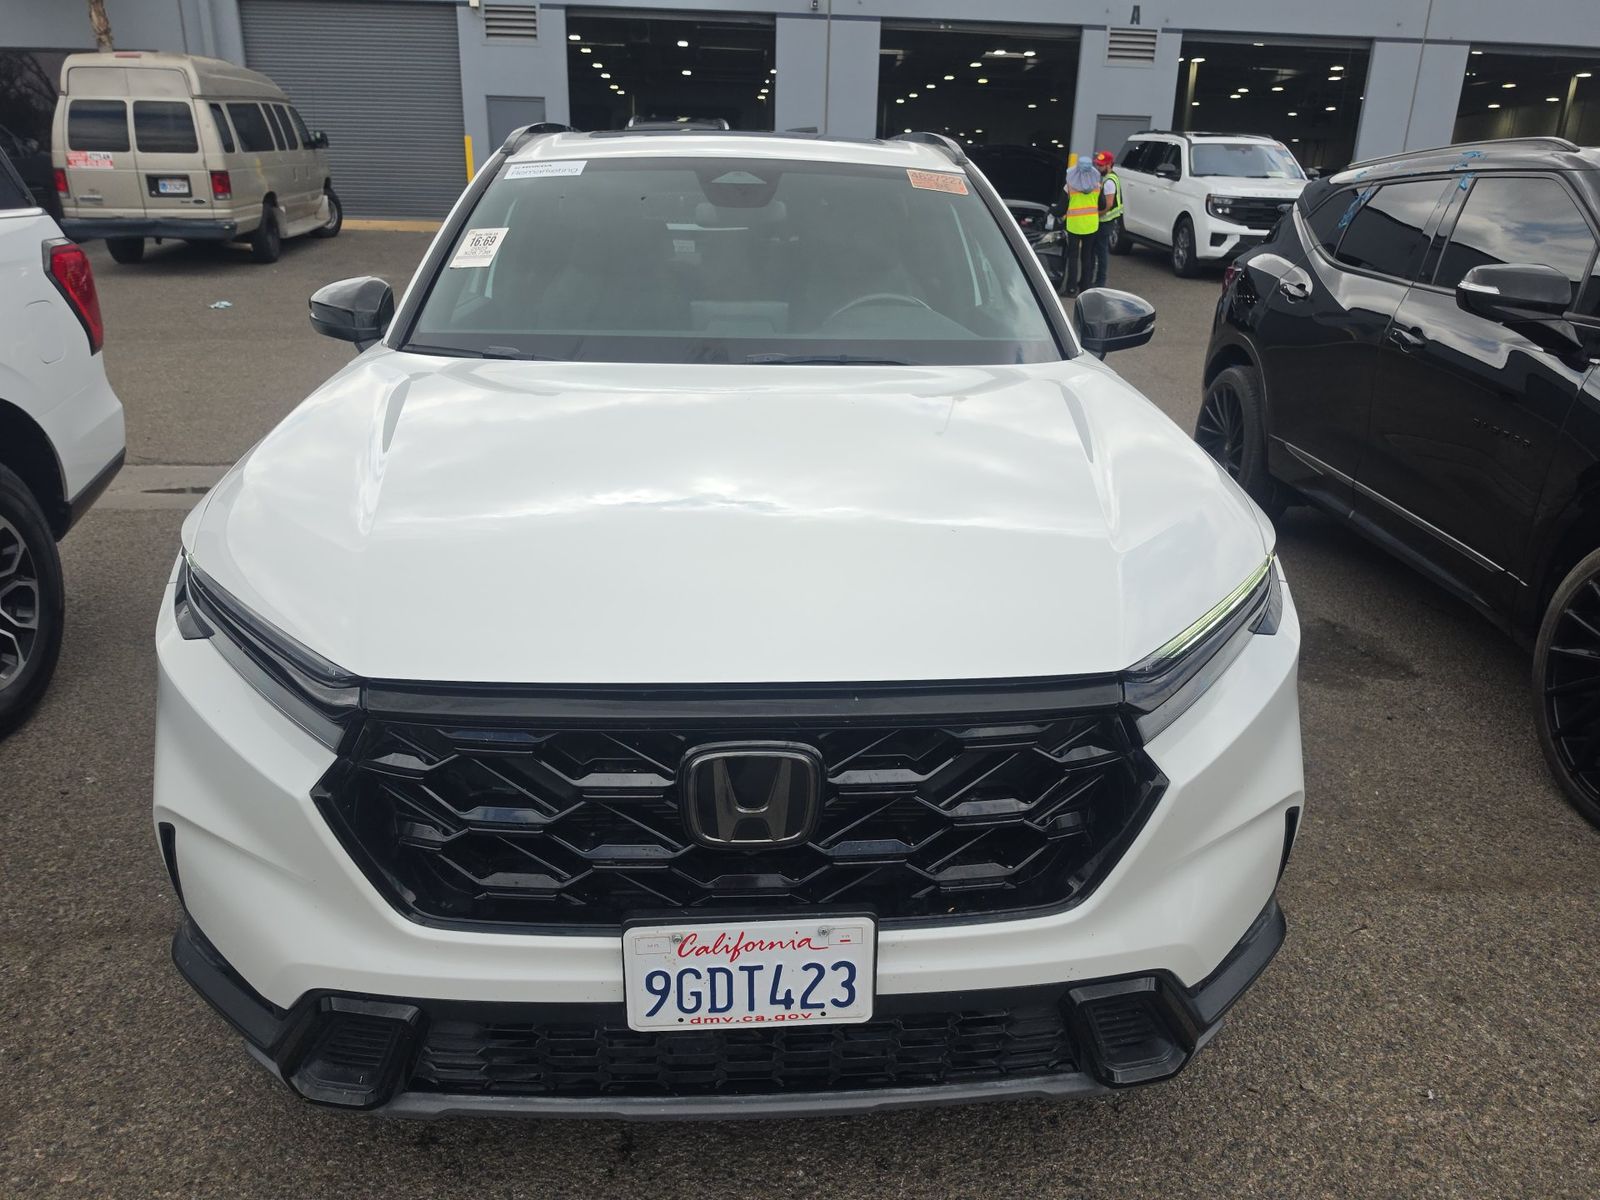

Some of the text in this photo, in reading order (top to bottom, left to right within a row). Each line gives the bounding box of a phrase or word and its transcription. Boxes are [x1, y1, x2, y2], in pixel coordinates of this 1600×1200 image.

[470, 236, 496, 247] 16:69
[677, 931, 829, 962] California
[645, 960, 857, 1017] 9GDT423
[690, 1012, 812, 1025] dmv.ca.gov
